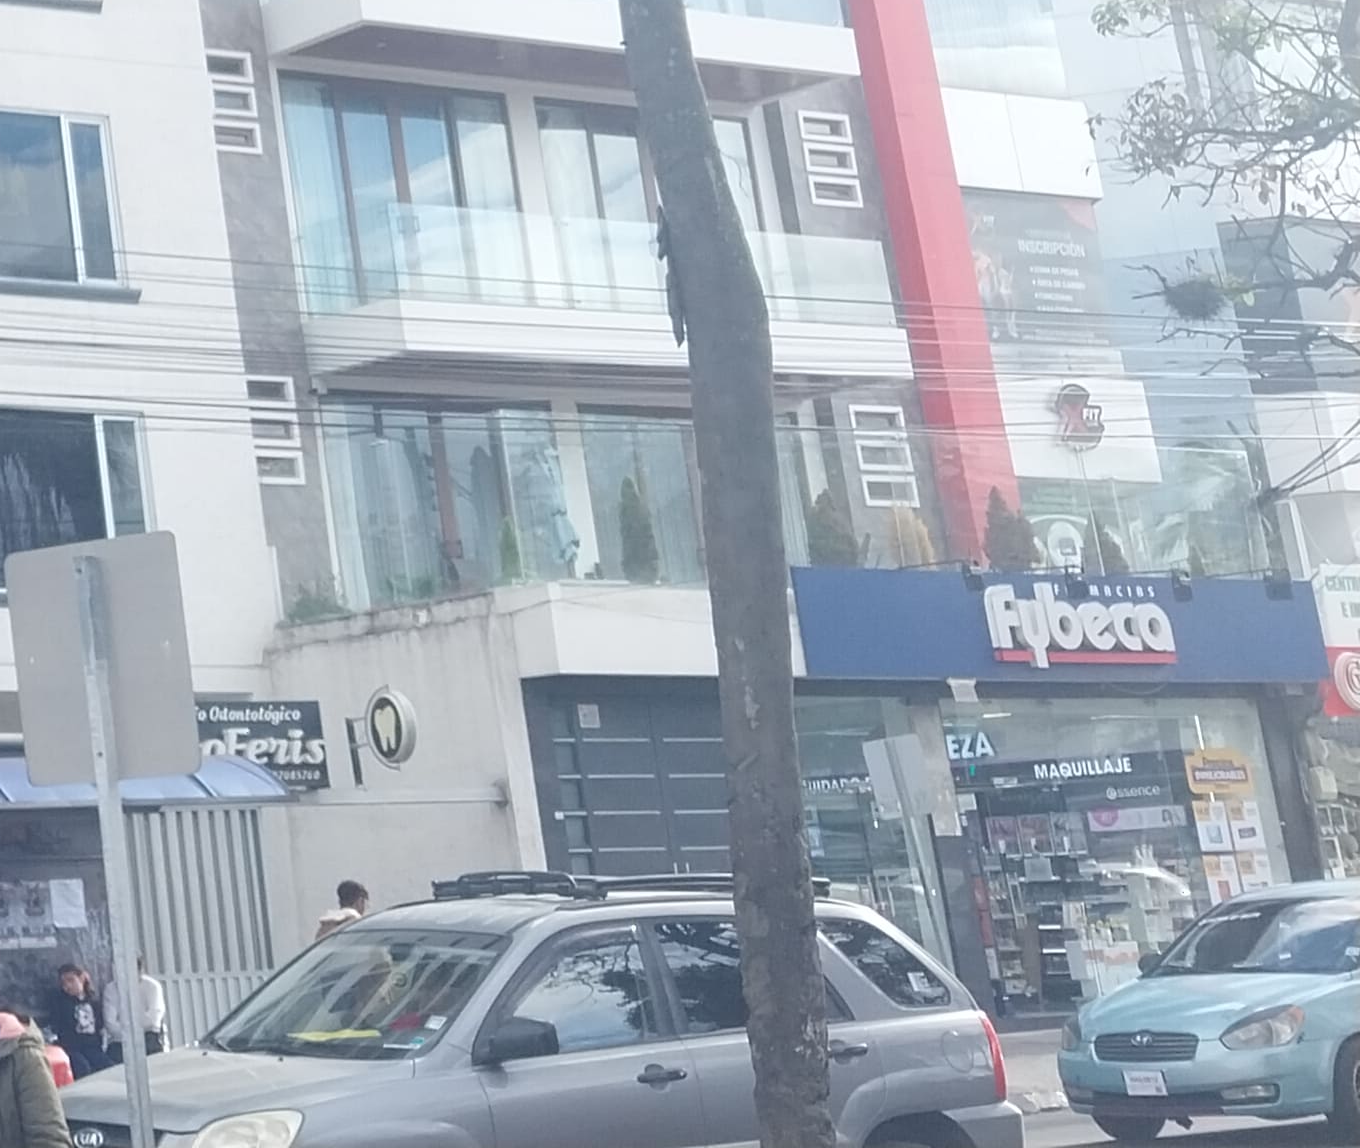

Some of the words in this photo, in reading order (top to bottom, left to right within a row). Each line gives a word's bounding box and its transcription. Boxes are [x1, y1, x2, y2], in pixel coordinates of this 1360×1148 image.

[1054, 583, 1156, 597] FMACIAS
[984, 582, 1176, 668] Fybeca
[209, 705, 301, 726] Odontológico
[199, 727, 326, 765] oFeris
[945, 730, 996, 760] EZA
[1034, 757, 1133, 780] MAQUILLAJE
